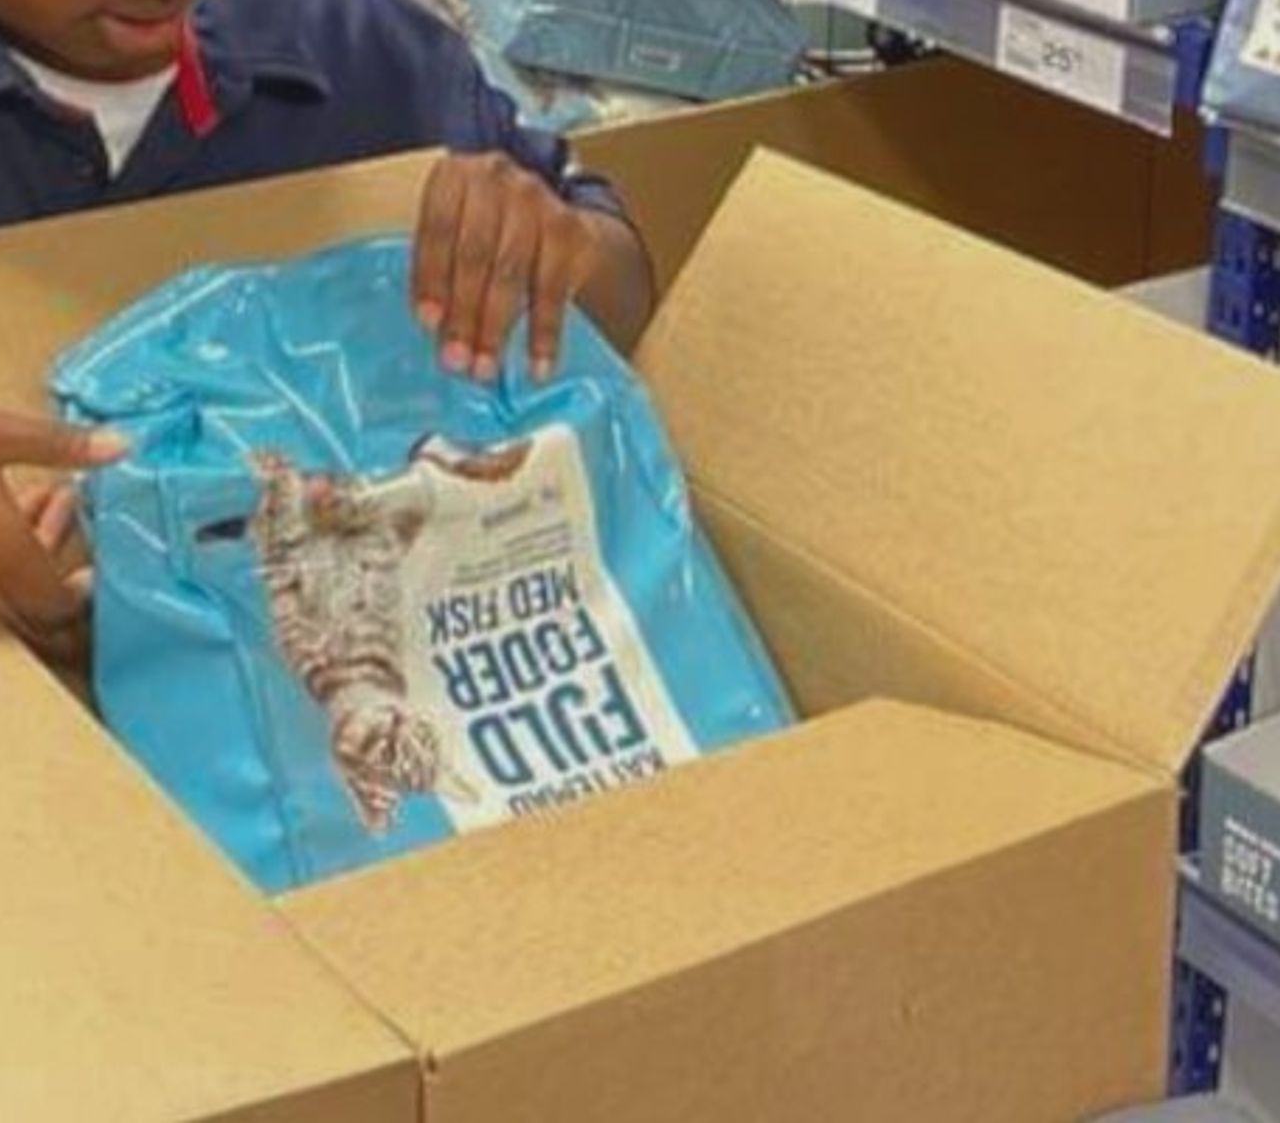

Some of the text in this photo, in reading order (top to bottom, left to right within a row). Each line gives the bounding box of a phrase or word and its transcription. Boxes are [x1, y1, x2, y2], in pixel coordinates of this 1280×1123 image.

[425, 560, 581, 645] MED FISK
[433, 604, 608, 712] FODER
[1222, 834, 1272, 884] SOFT
